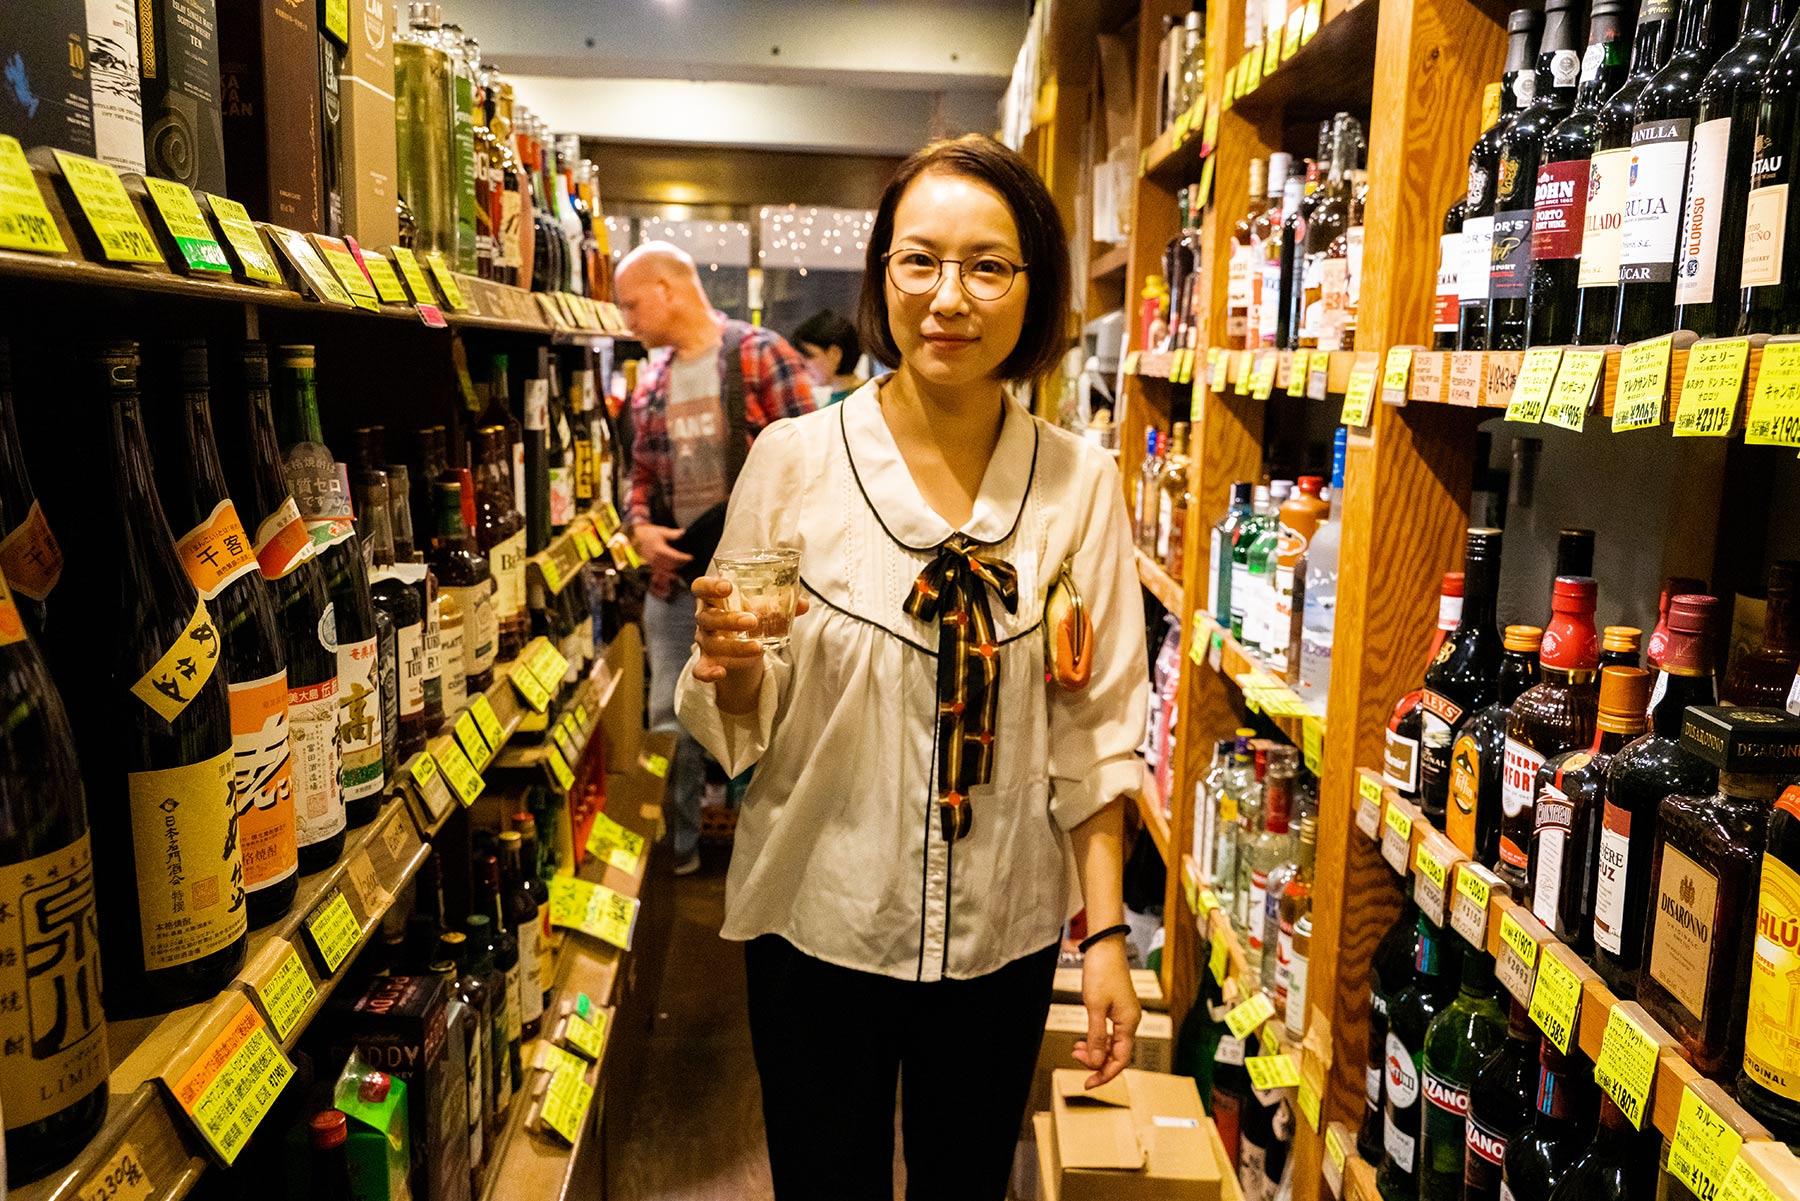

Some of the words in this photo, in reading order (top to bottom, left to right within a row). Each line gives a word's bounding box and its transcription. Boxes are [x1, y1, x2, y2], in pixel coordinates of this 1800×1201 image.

[190, 34, 203, 48] TEN
[1690, 197, 1705, 256] OLOROSO
[1700, 351, 1735, 364] シェリー
[1696, 407, 1726, 432] ¥2313
[1684, 721, 1724, 753] DISARONNO
[1535, 802, 1572, 828] COINTREAU
[164, 815, 185, 886] 日本名門酒会
[1661, 892, 1708, 943] DISARONNO
[1543, 1011, 1566, 1046] ¥1585
[1744, 1053, 1787, 1087] ORIGINAL
[1611, 1078, 1637, 1119] ¥1807
[1695, 1105, 1725, 1138] カルーア
